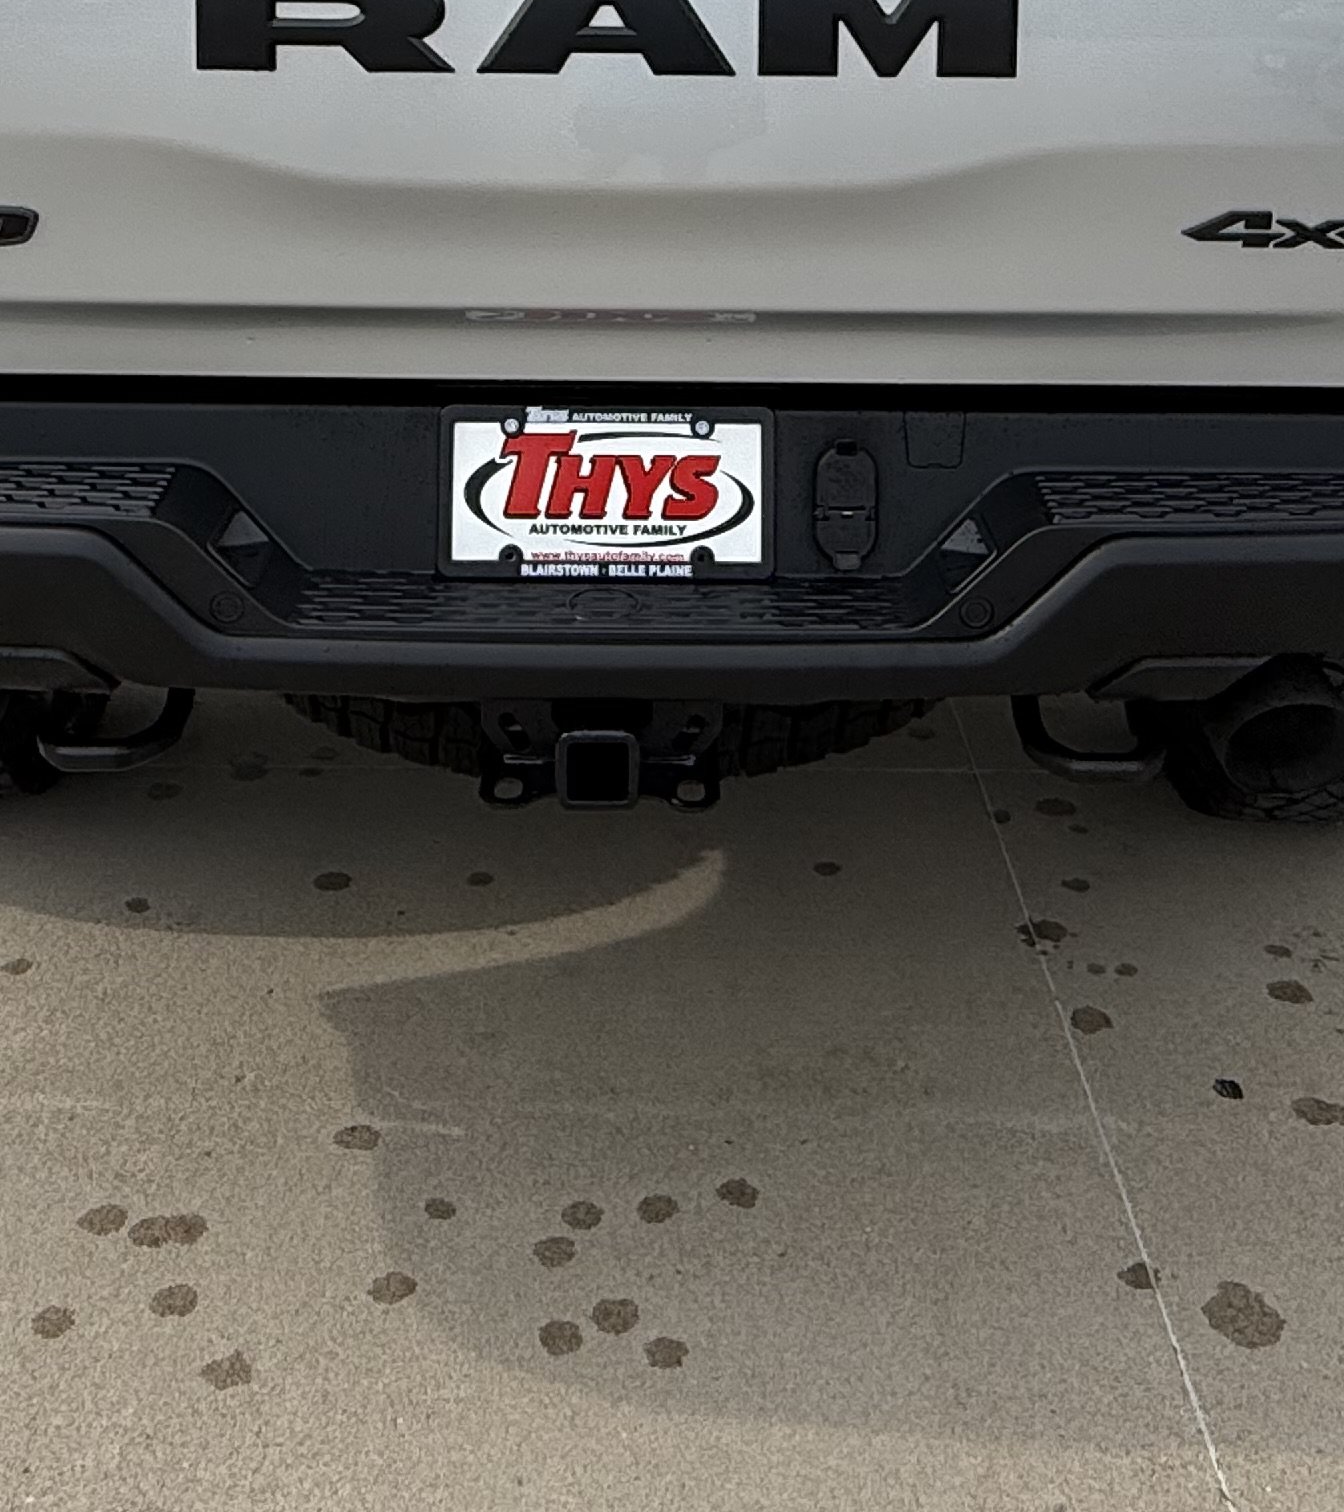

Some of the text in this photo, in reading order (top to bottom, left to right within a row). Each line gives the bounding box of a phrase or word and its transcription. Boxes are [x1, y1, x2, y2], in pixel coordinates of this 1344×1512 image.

[572, 412, 648, 422] AUTOMOTIVE
[651, 412, 693, 422] FAMILY
[501, 431, 720, 520] THYS
[529, 524, 687, 536] AUTOMOTIVE FAMILY
[521, 564, 693, 577] BLAIRSTOWN BELLE PLAINE
